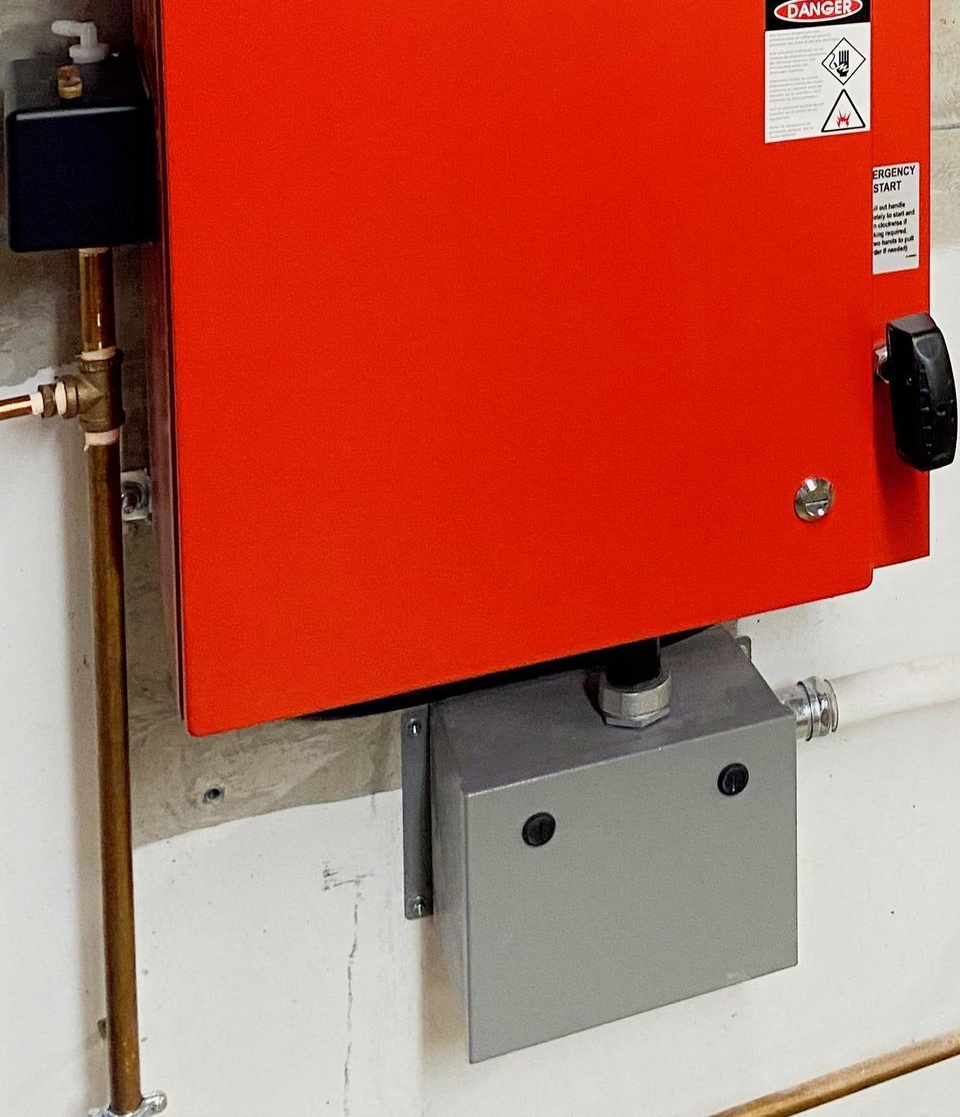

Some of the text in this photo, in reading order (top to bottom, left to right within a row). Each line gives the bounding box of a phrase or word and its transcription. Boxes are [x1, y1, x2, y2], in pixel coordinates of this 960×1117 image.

[787, 0, 852, 19] DANGER
[873, 181, 902, 193] START
[888, 202, 905, 210] handle
[893, 210, 905, 218] start
[878, 220, 902, 229] clockwise
